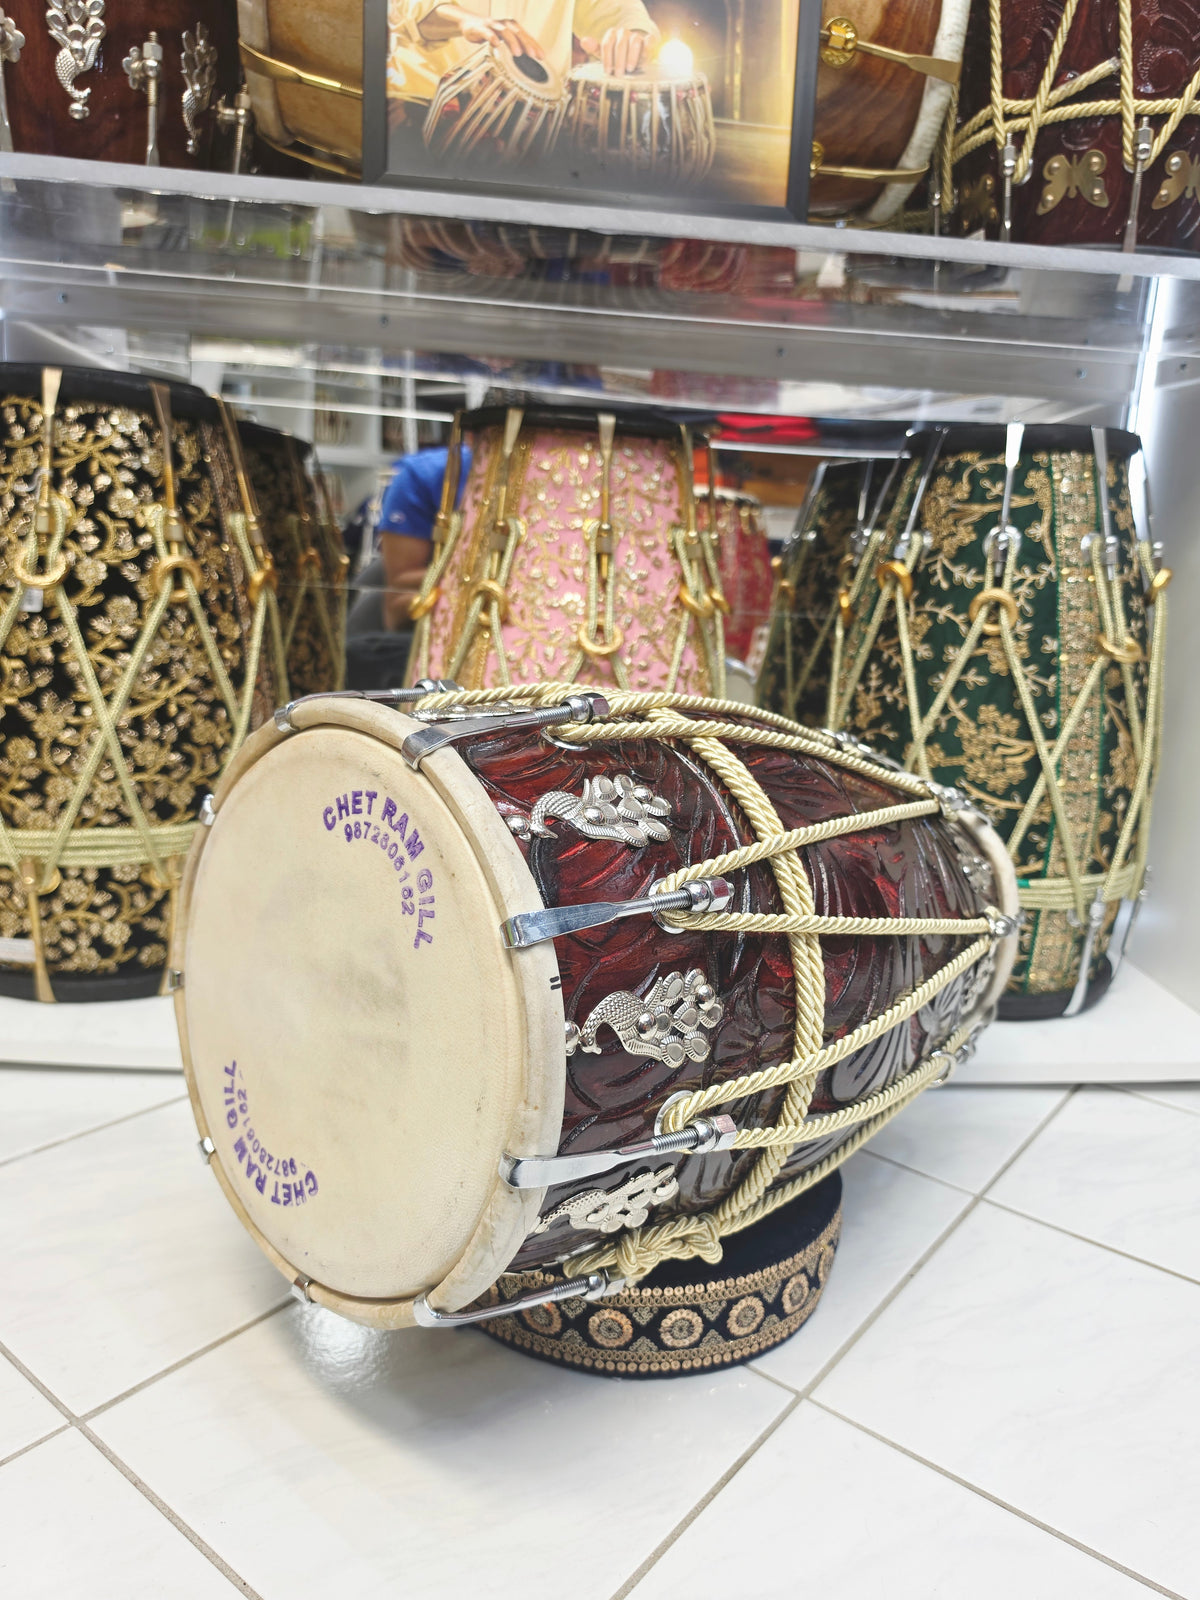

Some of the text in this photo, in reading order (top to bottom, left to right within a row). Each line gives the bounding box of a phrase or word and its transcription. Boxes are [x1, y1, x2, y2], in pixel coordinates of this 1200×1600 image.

[323, 790, 436, 949] CHET RAM GILL
[224, 1060, 319, 1206] CHET RAM GILL
